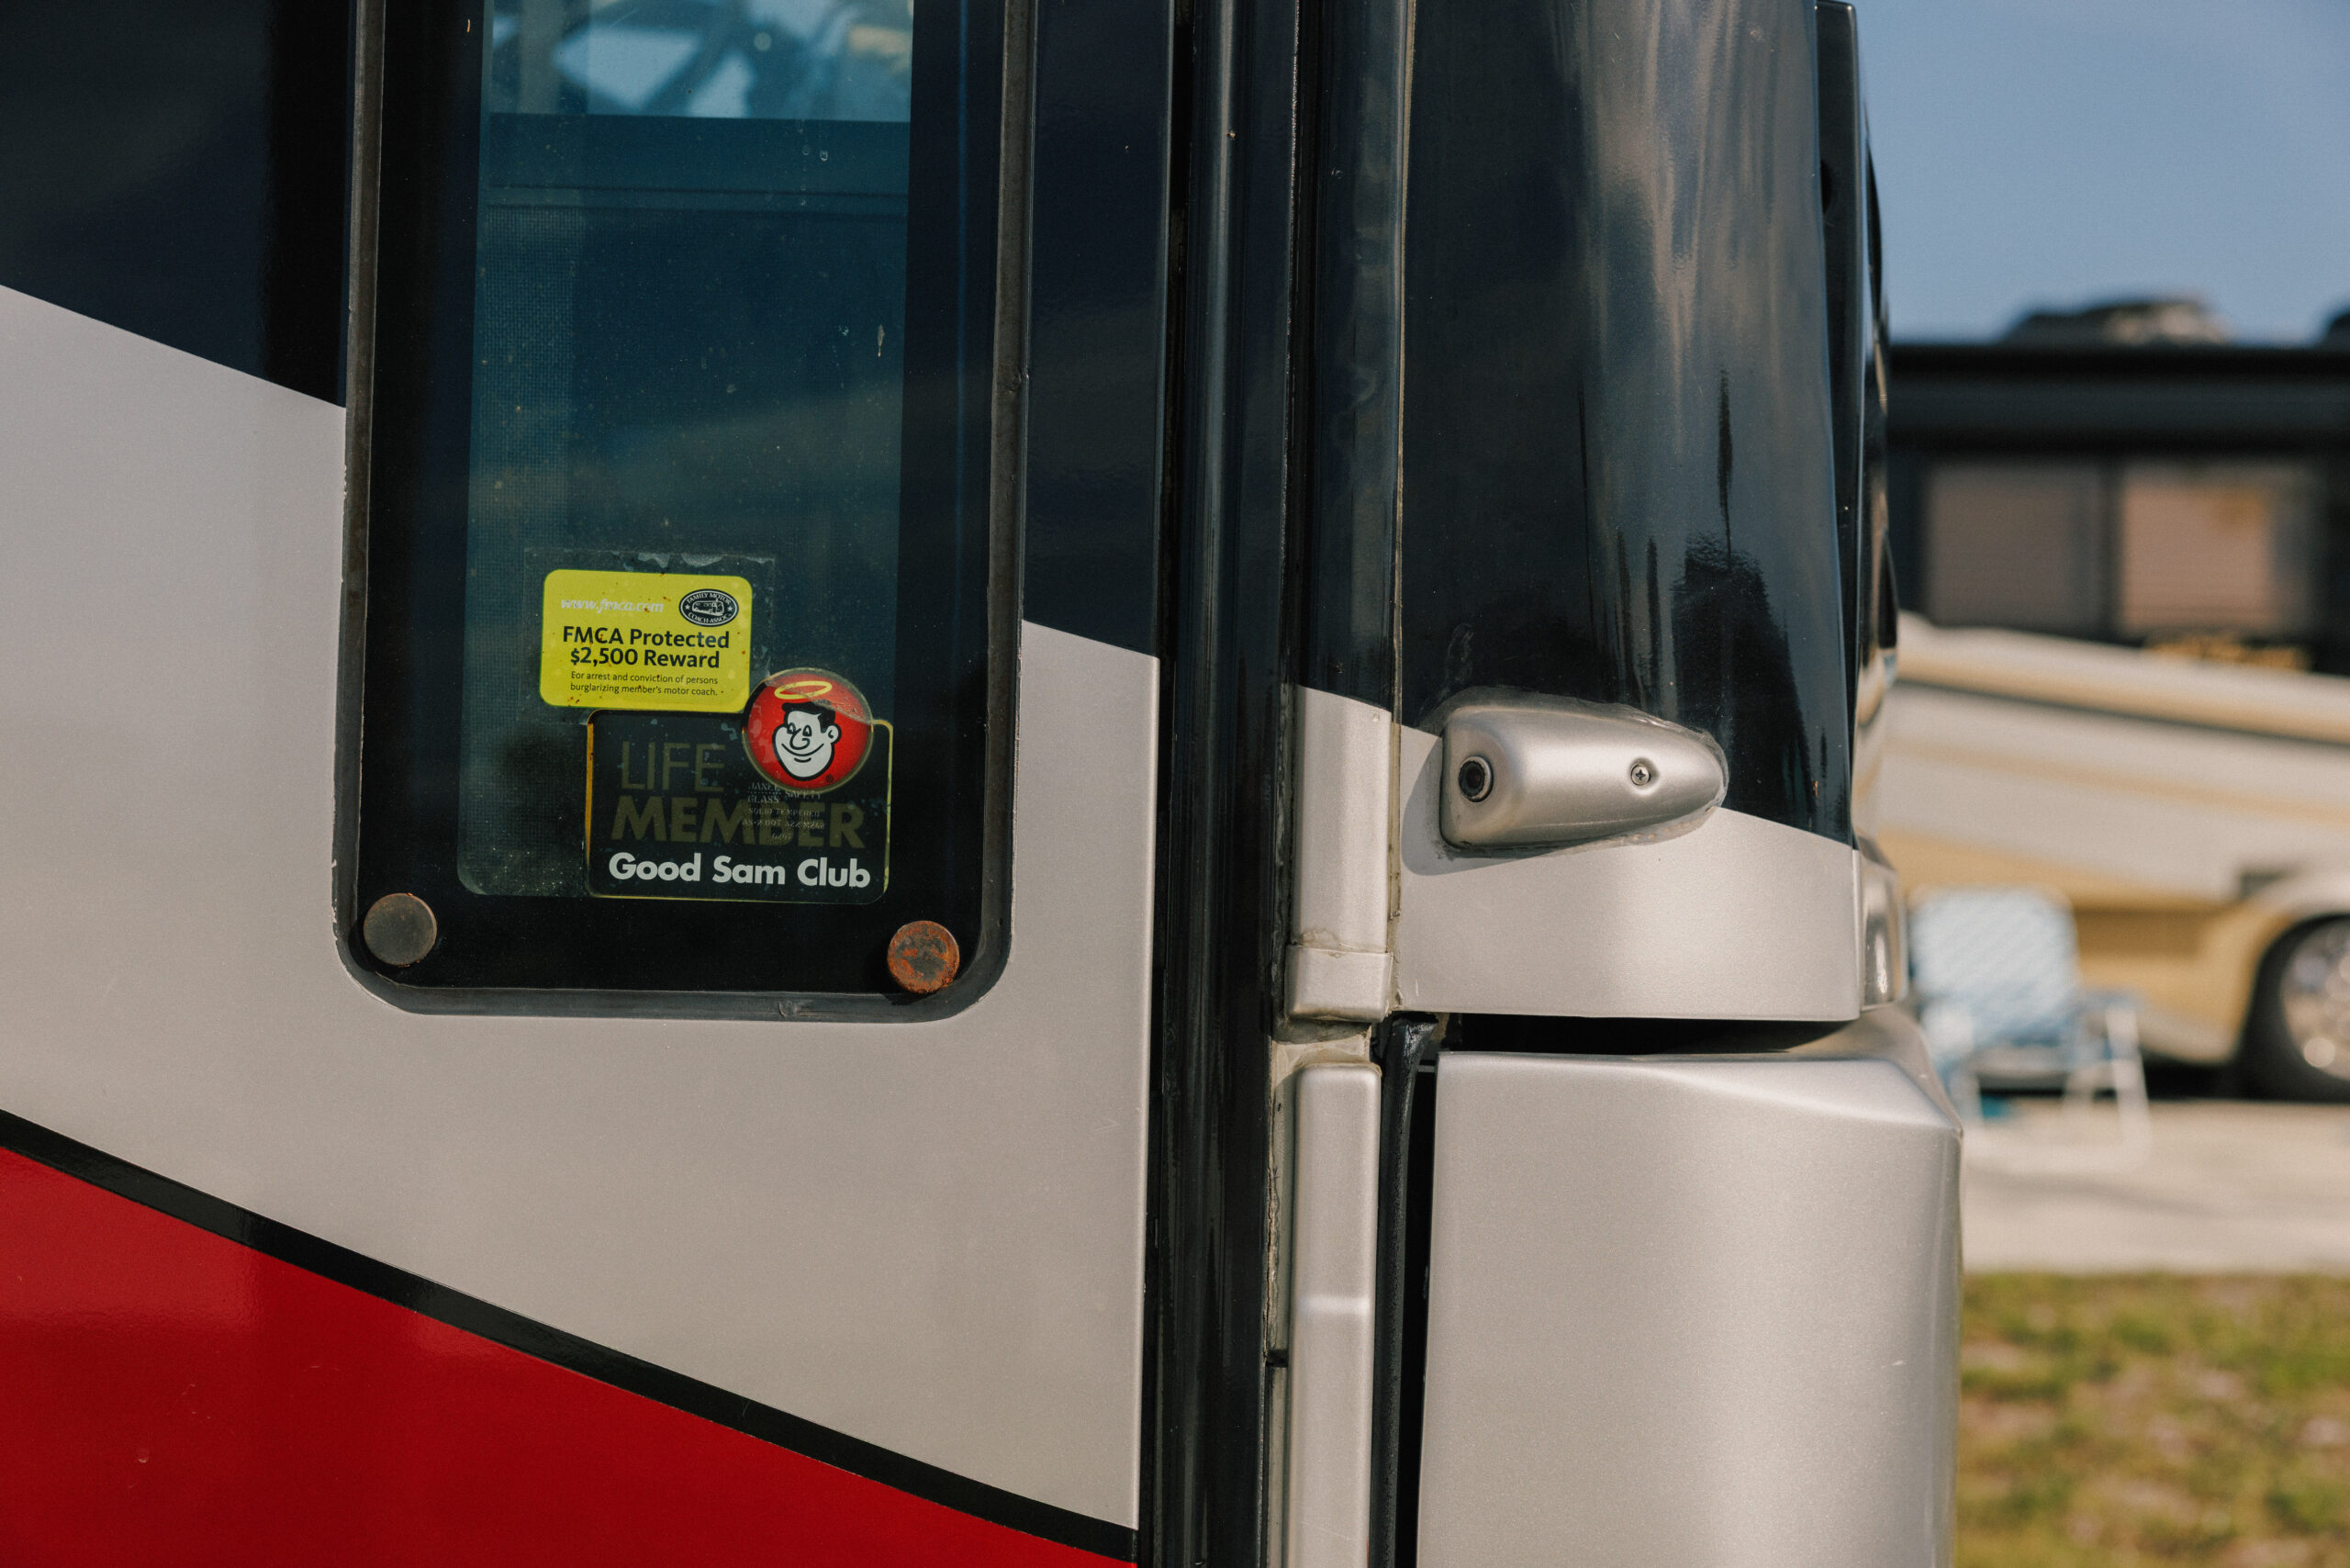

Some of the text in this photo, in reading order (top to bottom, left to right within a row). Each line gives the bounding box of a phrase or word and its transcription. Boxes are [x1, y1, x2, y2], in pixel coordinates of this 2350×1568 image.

[561, 599, 664, 613] www.fmca.com
[687, 592, 732, 605] FAMILY MOTOR
[688, 611, 709, 623] COACH
[563, 626, 729, 648] FMCA Protected
[570, 647, 720, 668] $2,500 Reward
[571, 671, 718, 685] For arrest and conviction of persons
[570, 682, 718, 696] burglarizing member's motor coach.
[621, 740, 726, 792] LIFE
[610, 795, 866, 849] MEMBER
[609, 852, 871, 888] Good Sam Club
